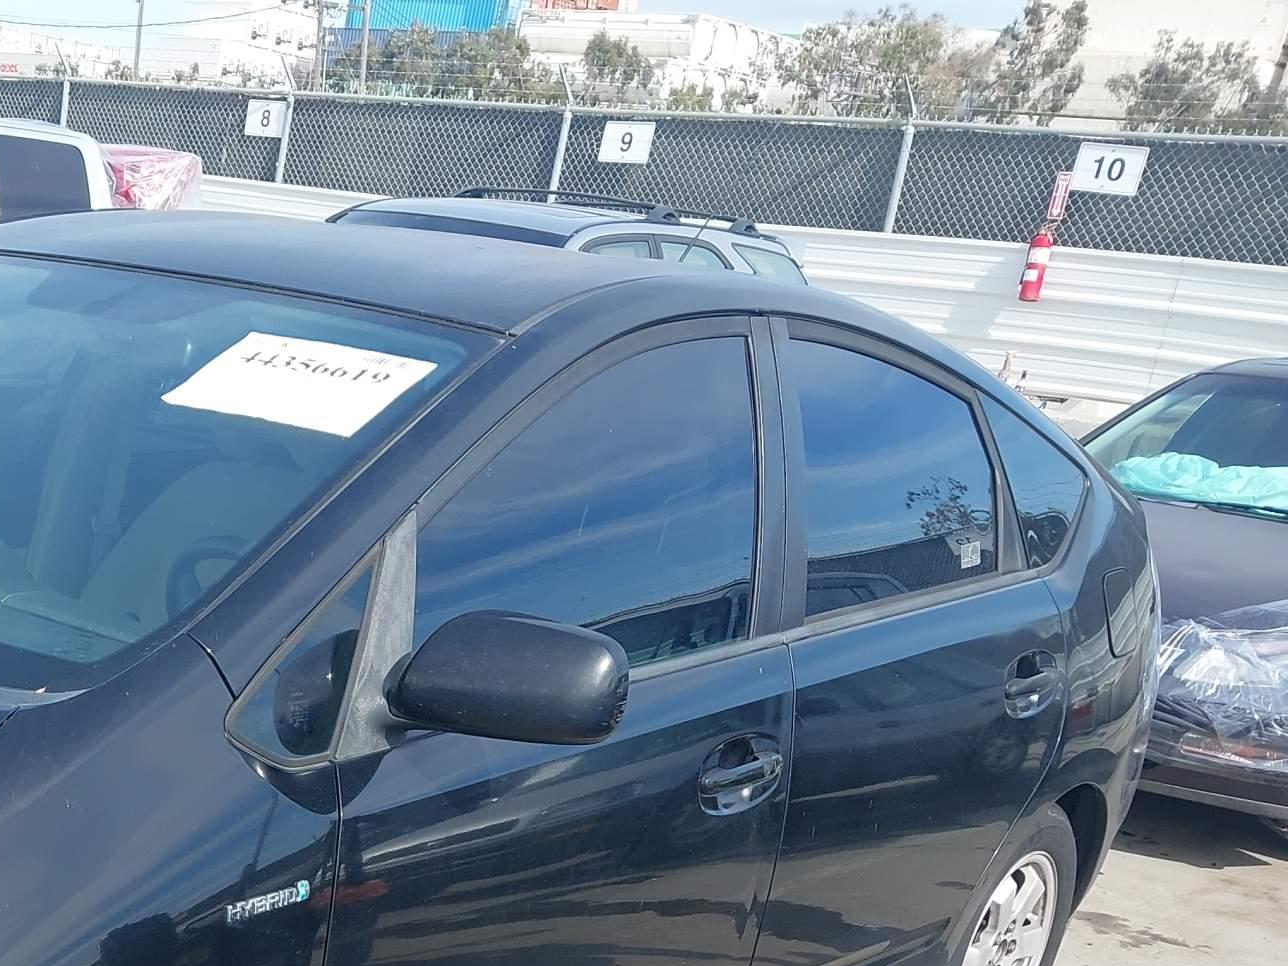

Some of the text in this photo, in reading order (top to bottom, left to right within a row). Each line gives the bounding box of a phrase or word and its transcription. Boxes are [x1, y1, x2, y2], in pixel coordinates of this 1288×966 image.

[260, 109, 271, 128] 8
[620, 131, 633, 152] 9
[1093, 156, 1126, 182] 10
[240, 350, 391, 385] 44356619
[224, 886, 299, 923] HYBRID
